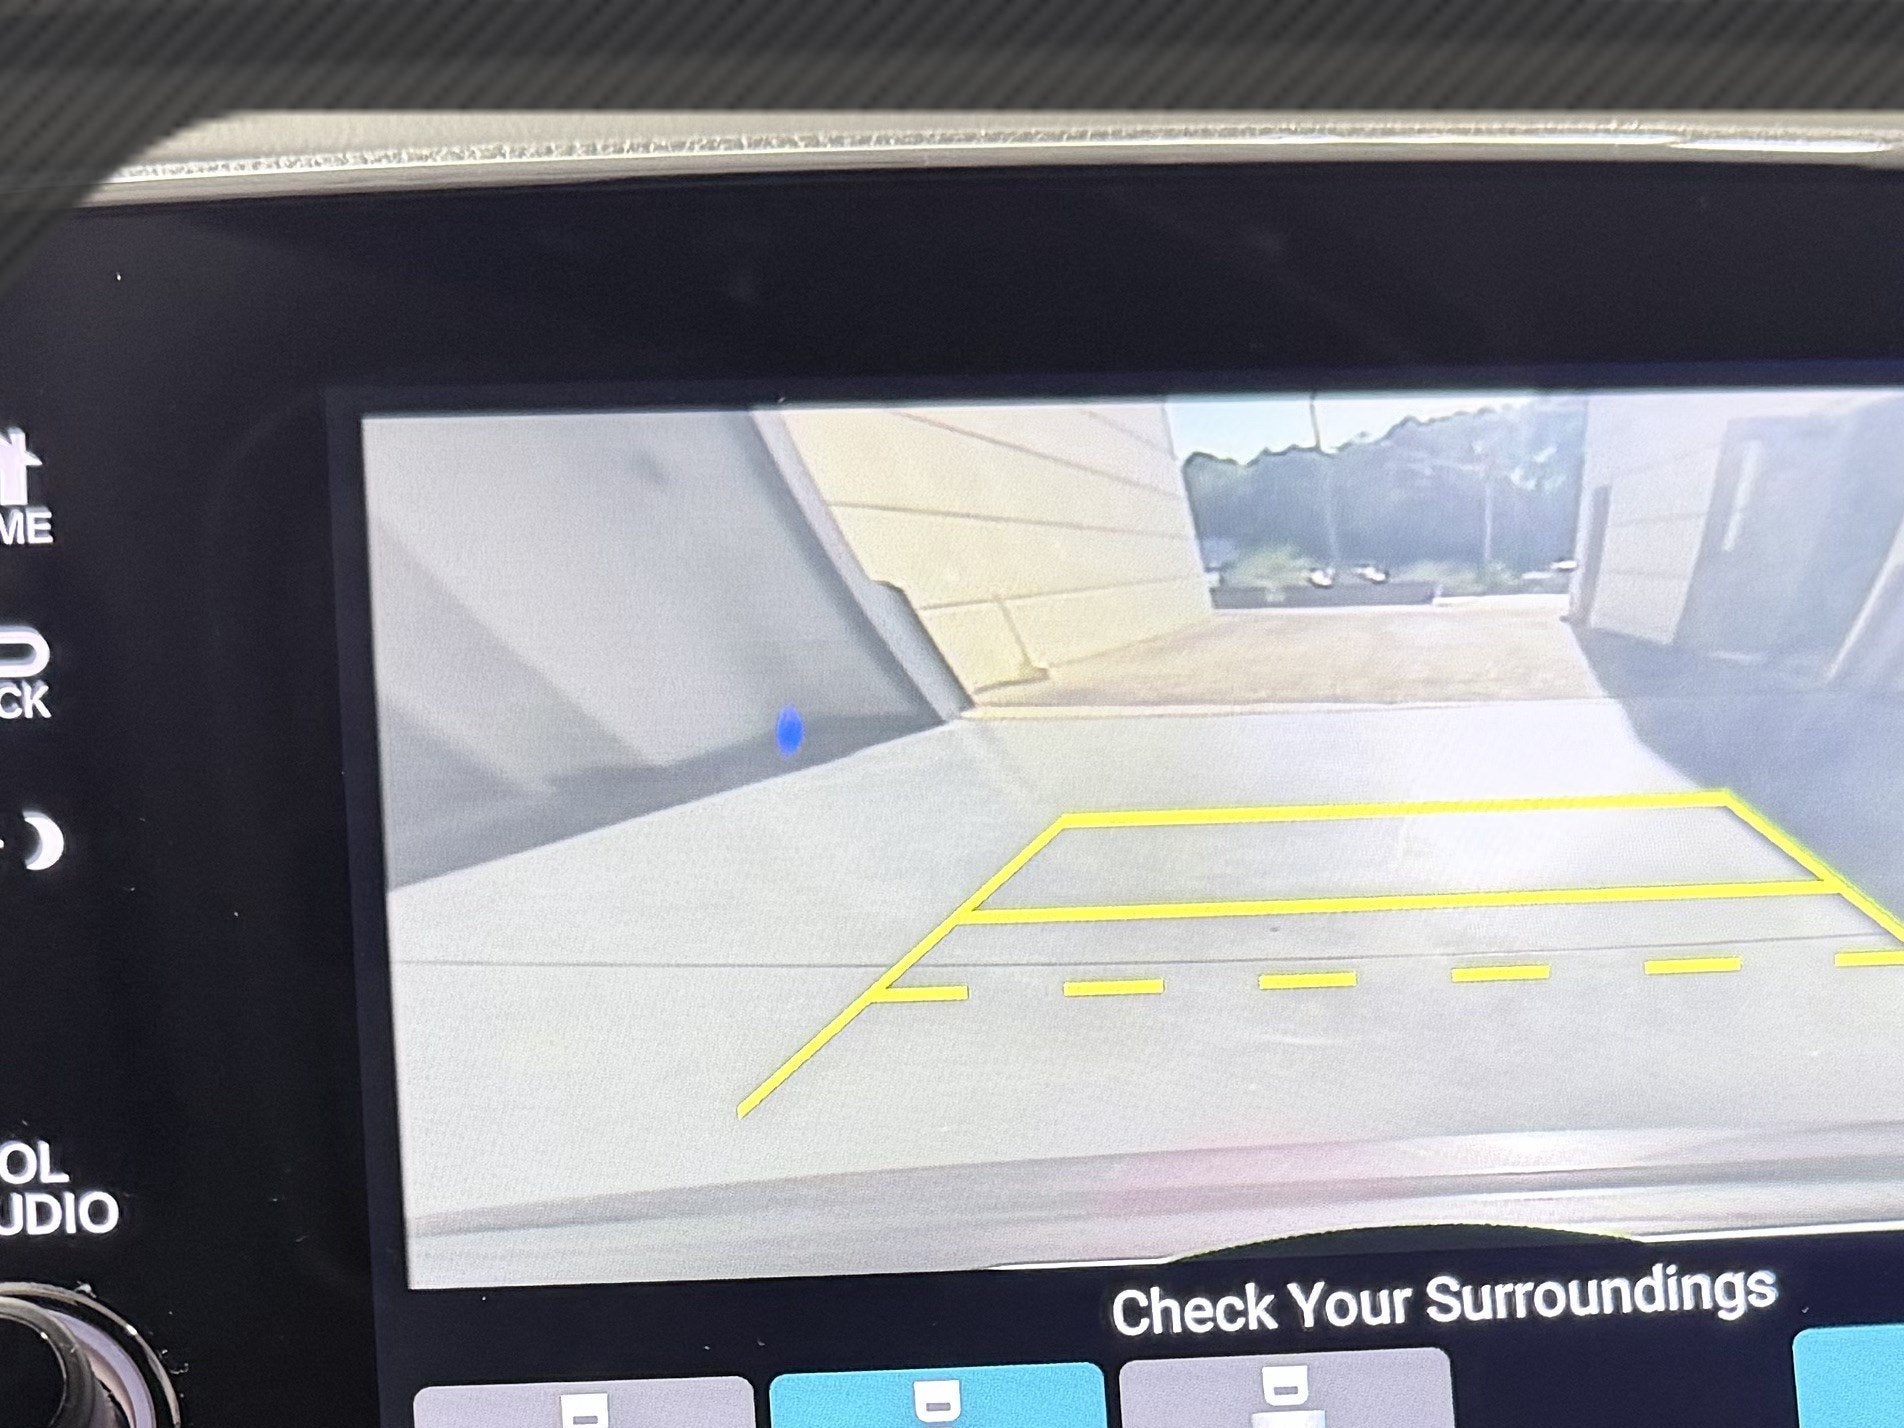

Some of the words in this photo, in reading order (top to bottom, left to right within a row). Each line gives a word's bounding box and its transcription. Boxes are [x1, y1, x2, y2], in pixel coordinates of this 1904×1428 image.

[1111, 1281, 1279, 1338] Check
[1286, 1279, 1414, 1329] Your
[1424, 1262, 1779, 1323] Surroundings
